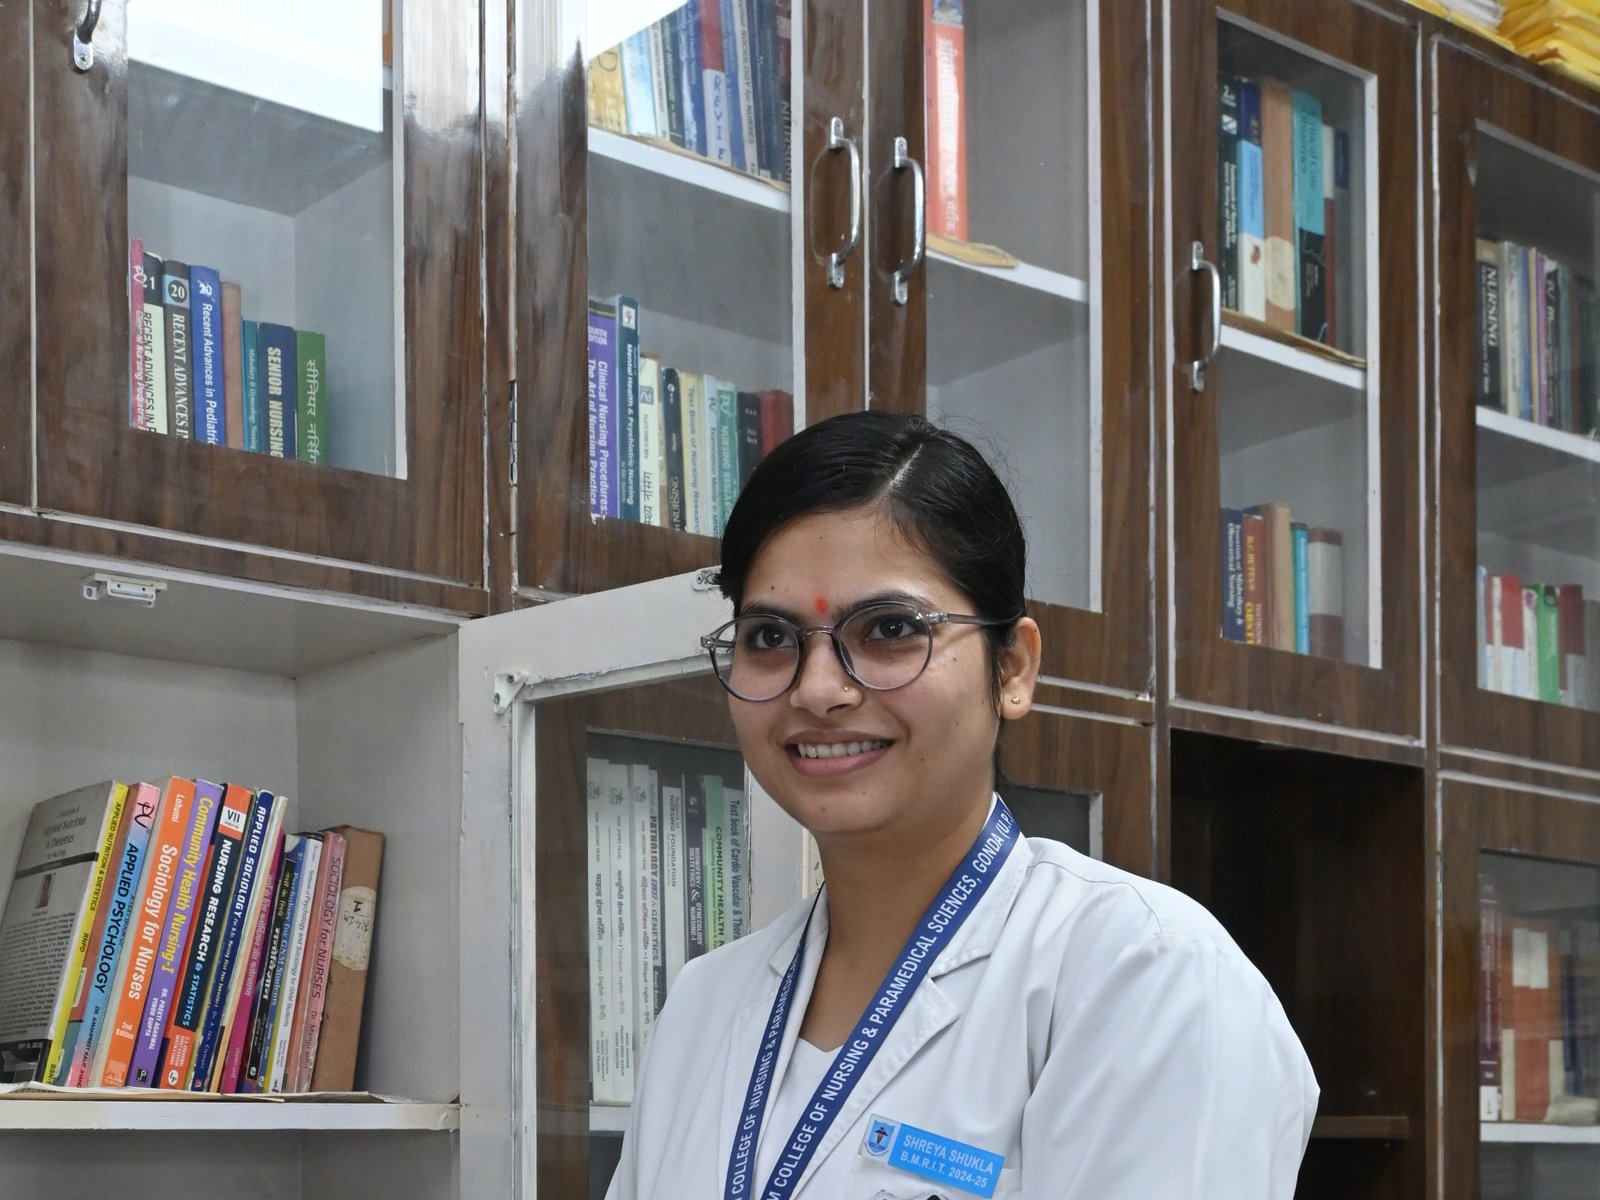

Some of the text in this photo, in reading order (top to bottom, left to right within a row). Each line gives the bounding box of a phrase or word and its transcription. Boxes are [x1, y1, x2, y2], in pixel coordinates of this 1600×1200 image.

[170, 284, 186, 299] 20
[1487, 267, 1498, 347] NURSING
[173, 313, 188, 427] RECENT ADVANCES
[203, 303, 215, 398] Recent Advances in
[267, 346, 282, 396] SENIOR
[588, 359, 597, 379] The
[589, 381, 597, 398] Art
[598, 360, 609, 446] Clinical Nursing
[589, 415, 597, 457] Nursing
[589, 459, 598, 505] Practice
[672, 477, 680, 524] NURSING
[110, 802, 121, 831] APPLIED
[171, 793, 185, 823] Lohumi
[227, 809, 241, 823] VII
[730, 799, 739, 816] Text
[730, 817, 739, 834] book
[100, 832, 114, 868] NUTRITION
[250, 806, 266, 854] APPLIED
[117, 843, 139, 898] APPLIED
[212, 839, 233, 894] NURSING
[731, 848, 740, 872] Cardio
[972, 834, 1003, 874] GONDA
[90, 876, 104, 911] DIETETICS
[161, 797, 214, 974] Community Health Nursing-I
[234, 856, 254, 918] SOCIOLOGY
[731, 874, 741, 908] Vascular
[927, 874, 983, 934] SCIENCES,
[128, 844, 178, 1001] Sociology for Nurses
[196, 896, 219, 962] RESEARCH
[299, 895, 311, 930] Psychology
[312, 857, 341, 999] SOCIOLOGY for NURSES
[717, 894, 725, 936] HEALTH
[80, 932, 89, 953] RNPD
[95, 900, 127, 994] PSYCHOLOGY
[290, 946, 302, 980] Sociology
[182, 974, 199, 1026] STATISTICS
[272, 966, 284, 1006] Students
[869, 934, 937, 1025] PARAMEDICAL
[145, 997, 157, 1036] VINOD GUPTA
[157, 1000, 166, 1021] PREETI
[765, 1039, 776, 1050] &
[861, 1027, 879, 1038] &
[748, 1051, 773, 1109] NURSING
[821, 1039, 869, 1101] NURSING
[743, 1112, 757, 1131] OF
[809, 1102, 829, 1122] OF
[732, 1131, 754, 1195] COLLEGE
[774, 1124, 818, 1188] COLLEGE
[900, 1152, 989, 1188] B.M.R.I.T. 2024-25
[903, 1134, 994, 1176] SHREYA SHUKLA
